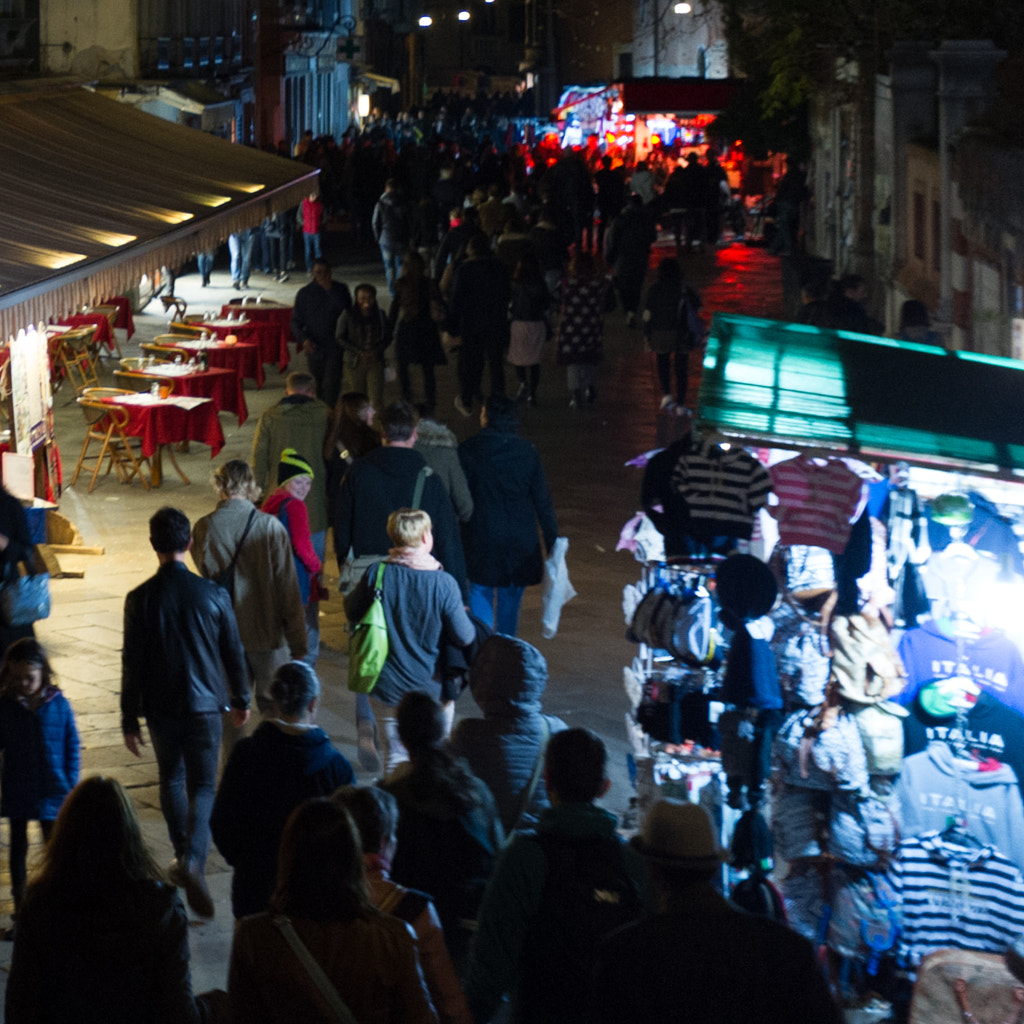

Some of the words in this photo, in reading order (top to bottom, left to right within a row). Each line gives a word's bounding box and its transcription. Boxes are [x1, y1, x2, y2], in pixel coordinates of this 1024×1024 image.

[931, 660, 1008, 687] ITALIA
[925, 726, 1005, 748] ITALIA
[919, 793, 996, 819] ITALIA
